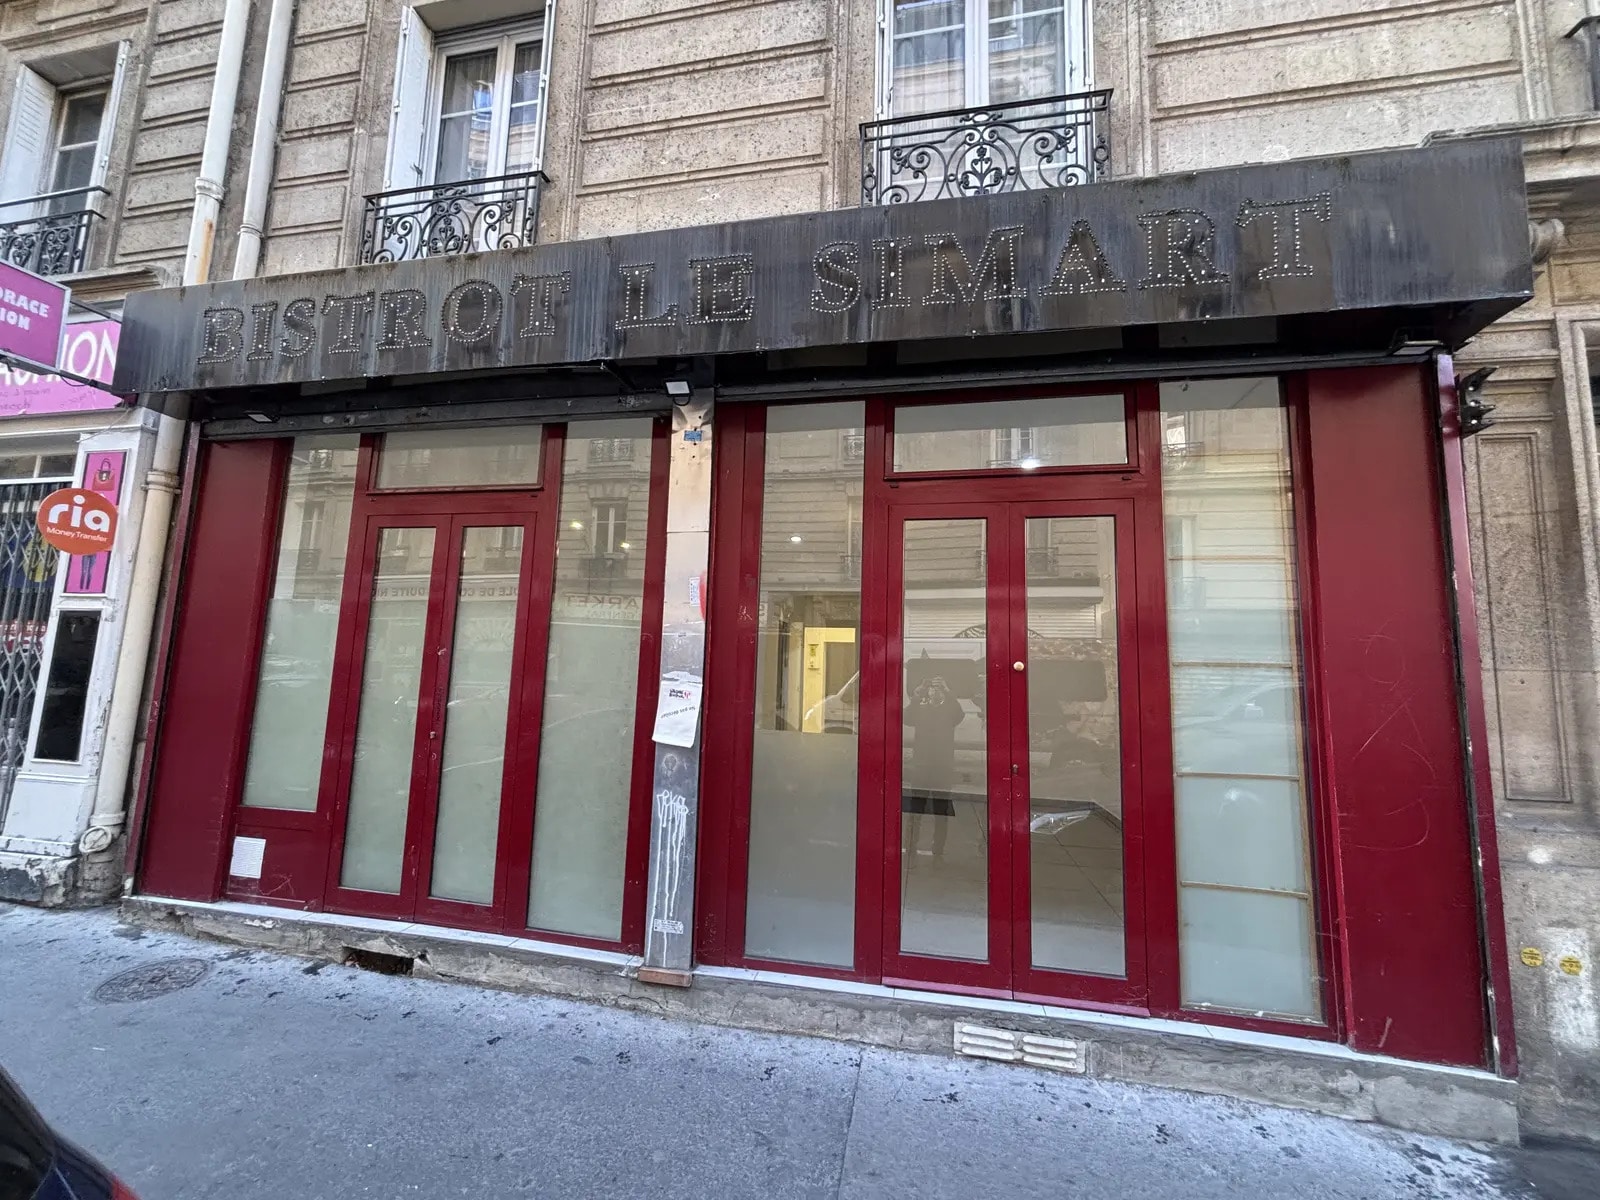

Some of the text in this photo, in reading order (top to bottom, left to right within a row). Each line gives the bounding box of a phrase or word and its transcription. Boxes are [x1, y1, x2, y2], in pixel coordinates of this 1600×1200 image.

[197, 192, 1332, 365] BISTROT LE SIMART
[0, 287, 50, 318] RACE
[47, 494, 111, 533] ria
[46, 526, 109, 542] Money Transfer
